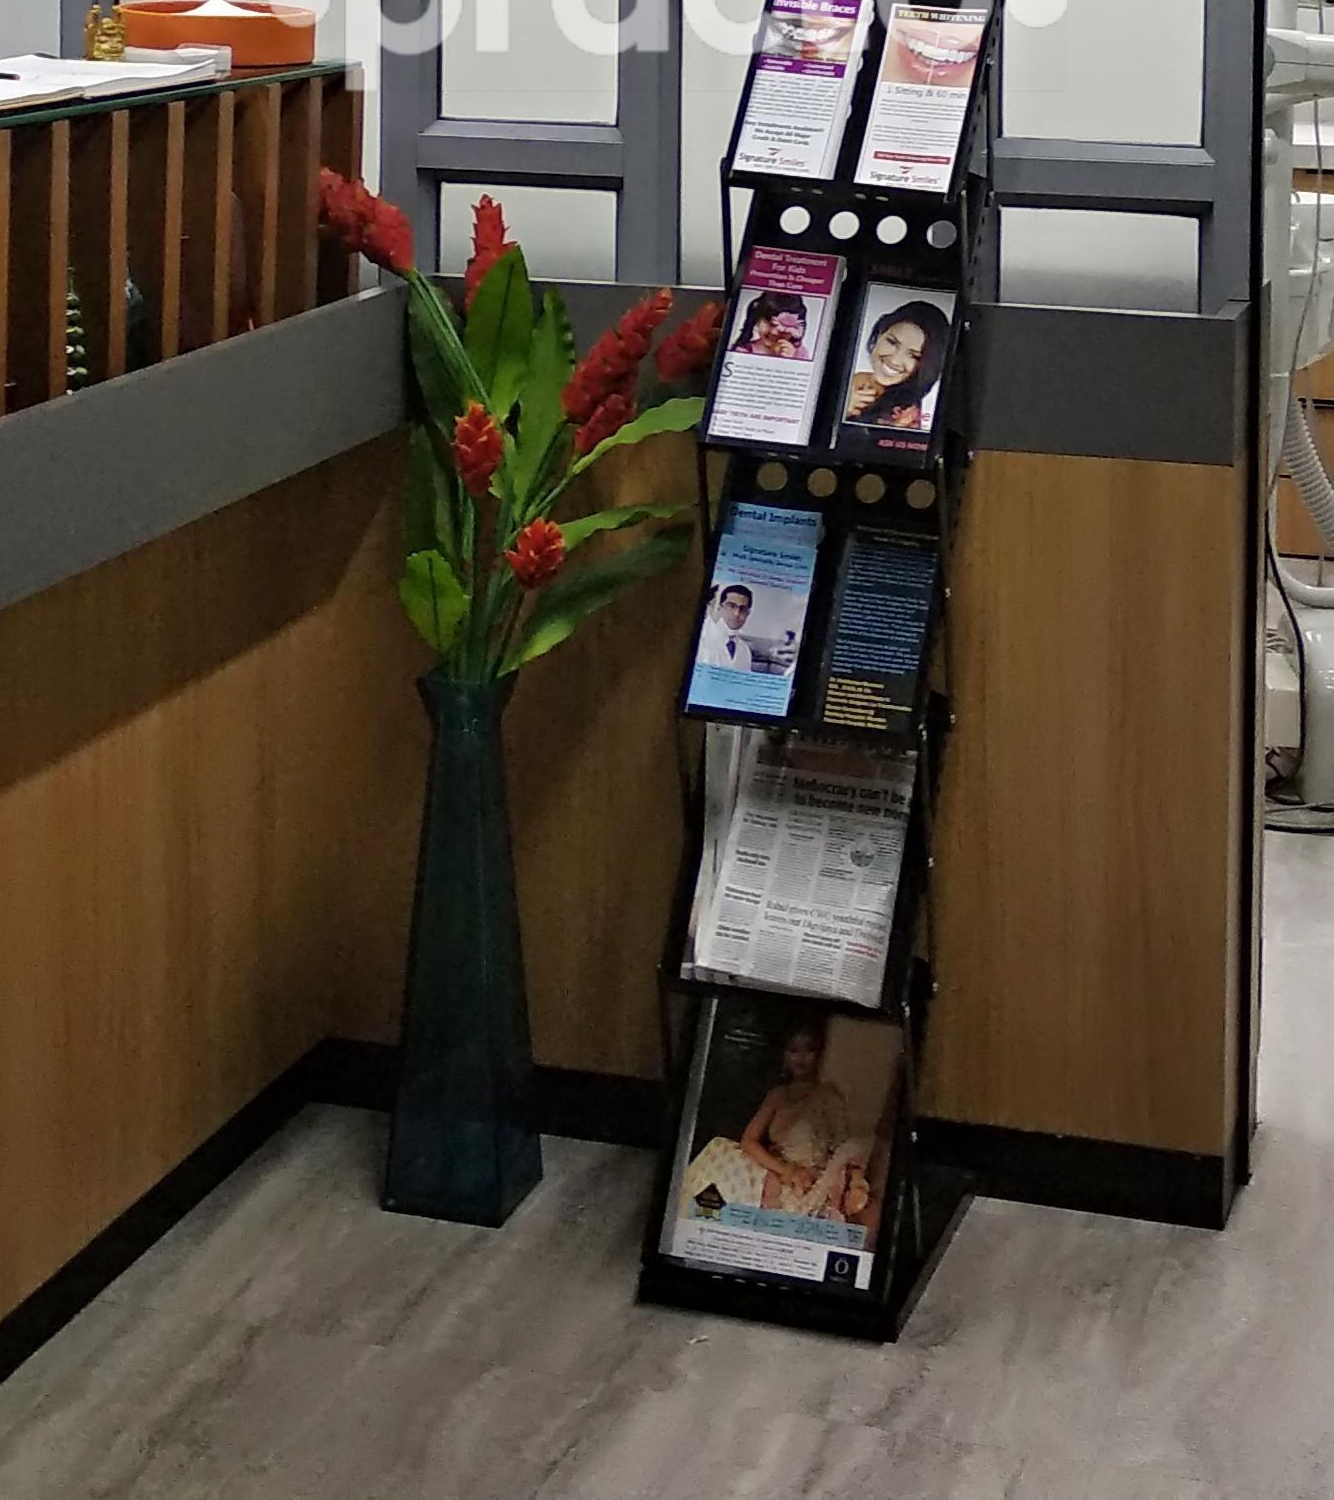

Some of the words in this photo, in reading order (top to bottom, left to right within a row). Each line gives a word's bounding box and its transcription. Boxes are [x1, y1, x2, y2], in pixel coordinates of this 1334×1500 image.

[821, 1, 855, 14] Braces
[897, 9, 929, 19] TEETH
[931, 12, 986, 22] WHITENING
[895, 86, 923, 98] Sitting
[936, 89, 948, 98] 60
[738, 152, 778, 164] Signature
[870, 171, 910, 182] Signature
[754, 250, 783, 261] Dental
[788, 265, 806, 274] Kids
[731, 505, 767, 520] Dental
[769, 512, 817, 527] Implants
